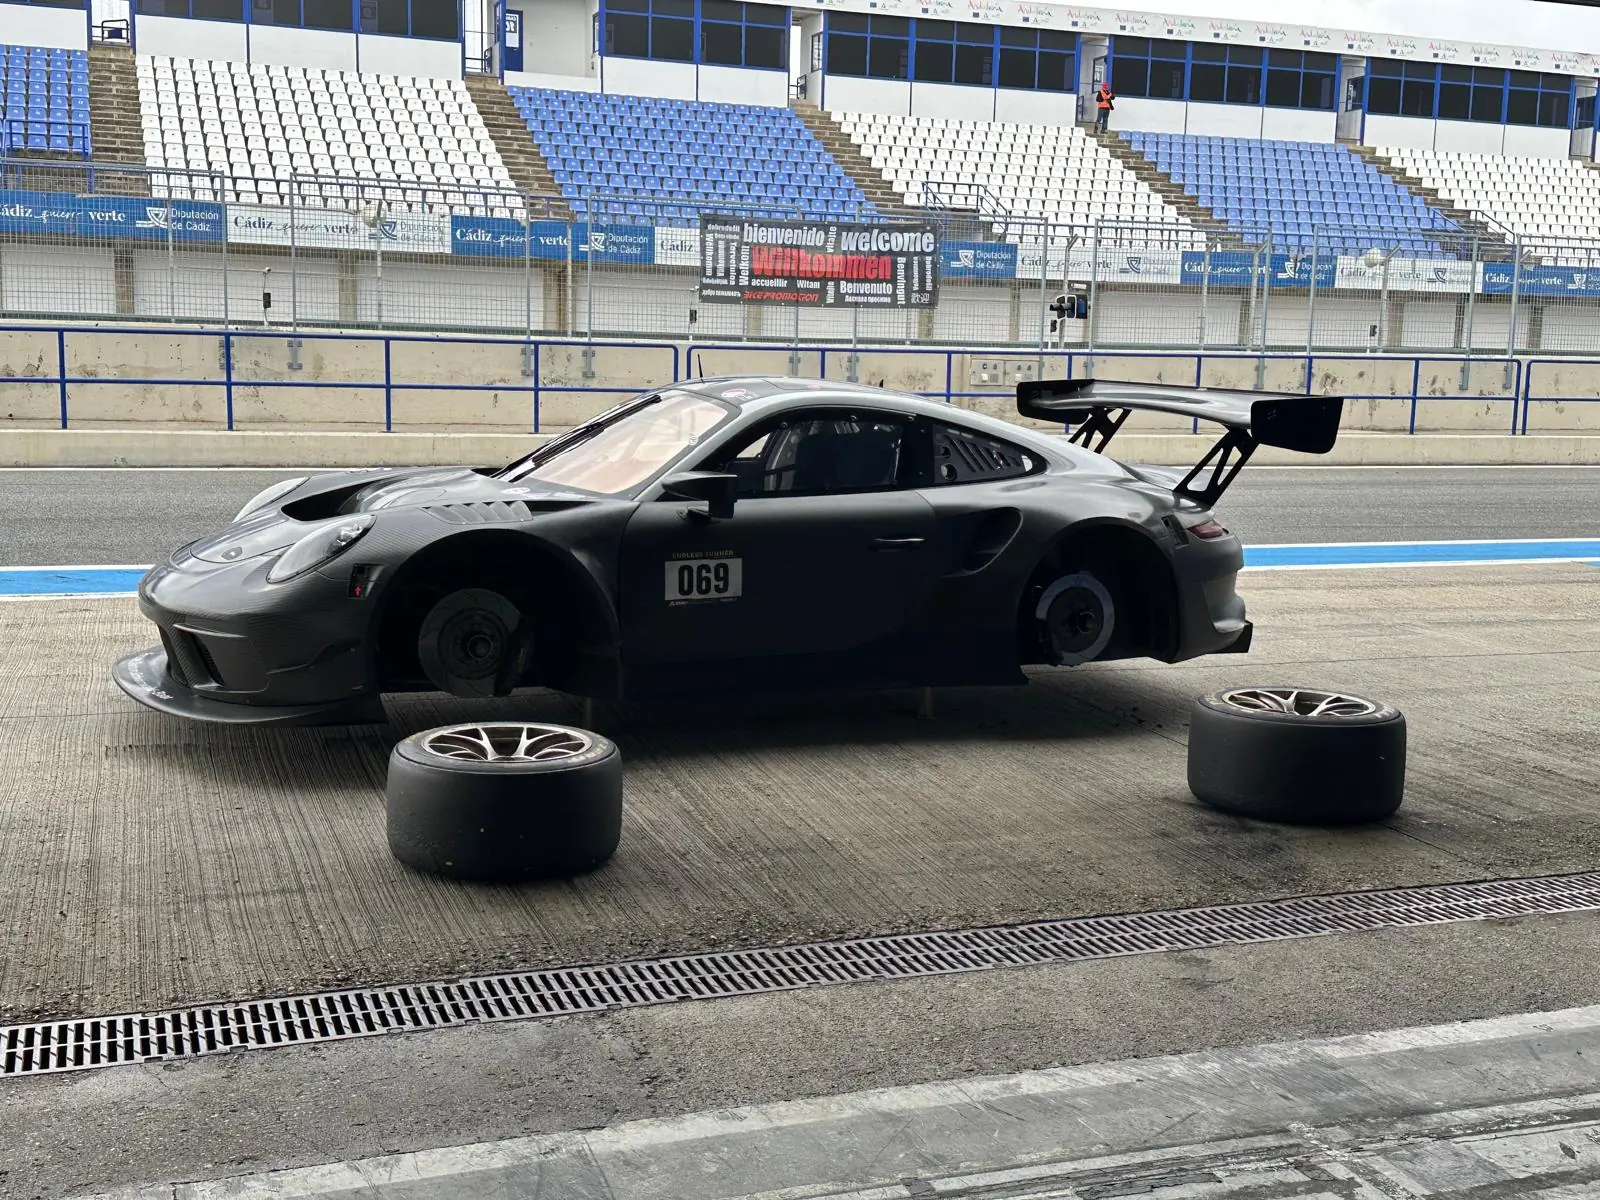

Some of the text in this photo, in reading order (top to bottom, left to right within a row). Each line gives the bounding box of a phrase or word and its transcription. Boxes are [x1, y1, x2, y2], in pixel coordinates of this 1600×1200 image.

[0, 204, 33, 217] ádiz
[88, 210, 126, 221] verte
[171, 208, 219, 220] Diputación
[171, 221, 211, 231] de Cádiz
[234, 215, 272, 230] Cádiz
[456, 228, 492, 242] Cádiz
[608, 233, 648, 243] Diputación
[743, 222, 825, 246] bienvenido
[841, 229, 935, 252] welcome
[608, 245, 617, 253] de
[661, 240, 694, 252] Cádiz
[976, 250, 1011, 260] Diputación
[1021, 255, 1050, 267] Cádz
[1087, 258, 1112, 269] vrte
[738, 245, 750, 286] Welkom
[752, 245, 892, 280] Willkommen
[1184, 261, 1212, 273] Cádz
[839, 280, 893, 295] Benvenuto
[678, 562, 729, 596] 069
